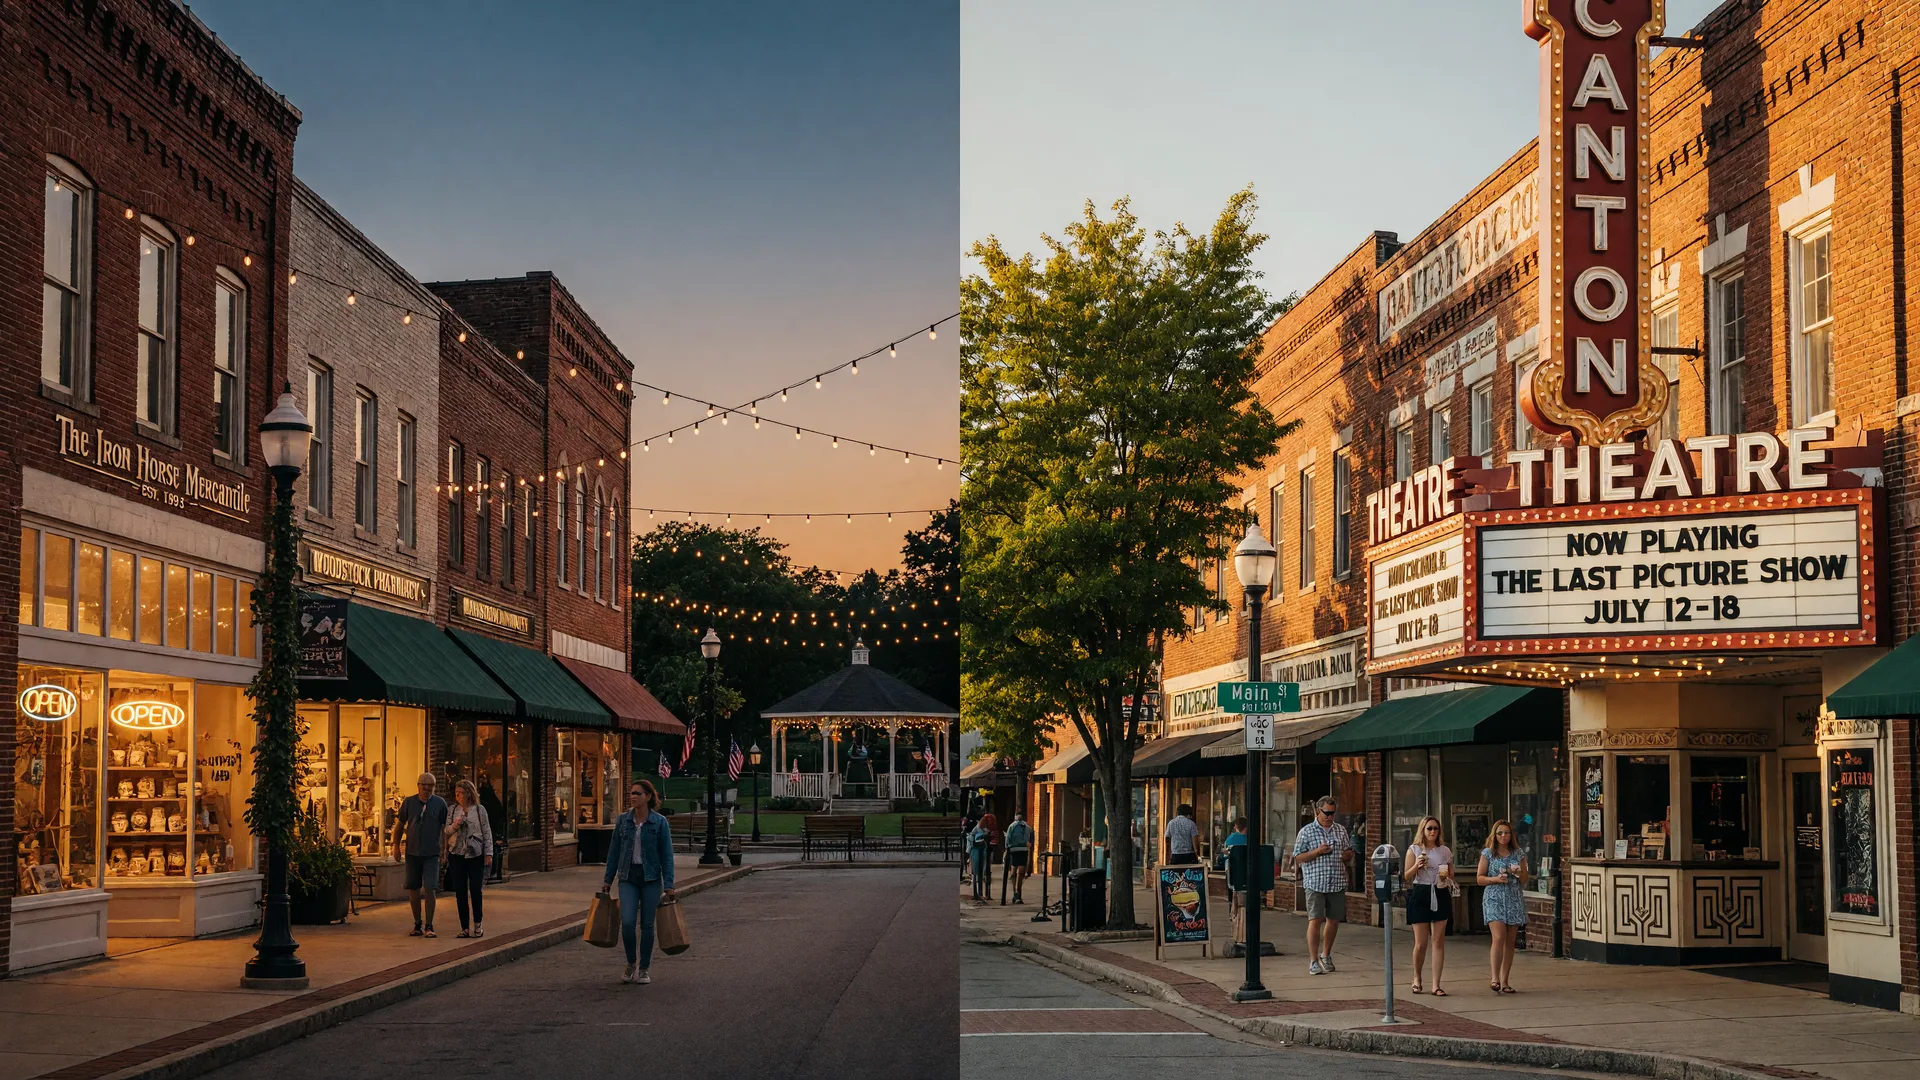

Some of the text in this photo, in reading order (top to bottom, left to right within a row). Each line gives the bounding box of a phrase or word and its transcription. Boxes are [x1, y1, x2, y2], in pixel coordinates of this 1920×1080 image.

[1572, 0, 1628, 395] CANTON
[56, 413, 89, 456] The
[1507, 427, 1828, 507] THEATRE
[141, 484, 160, 501] EST.
[1366, 456, 1455, 545] THEATRE
[1566, 524, 1760, 557] NOW PLAYING
[1491, 554, 1848, 594] THE LAST PICTURE SHOW
[1583, 595, 1741, 623] JULY 12-18
[1329, 652, 1352, 676] BANK
[24, 690, 71, 717] OPEN
[1232, 684, 1268, 701] Main
[117, 704, 178, 726] OPEN
